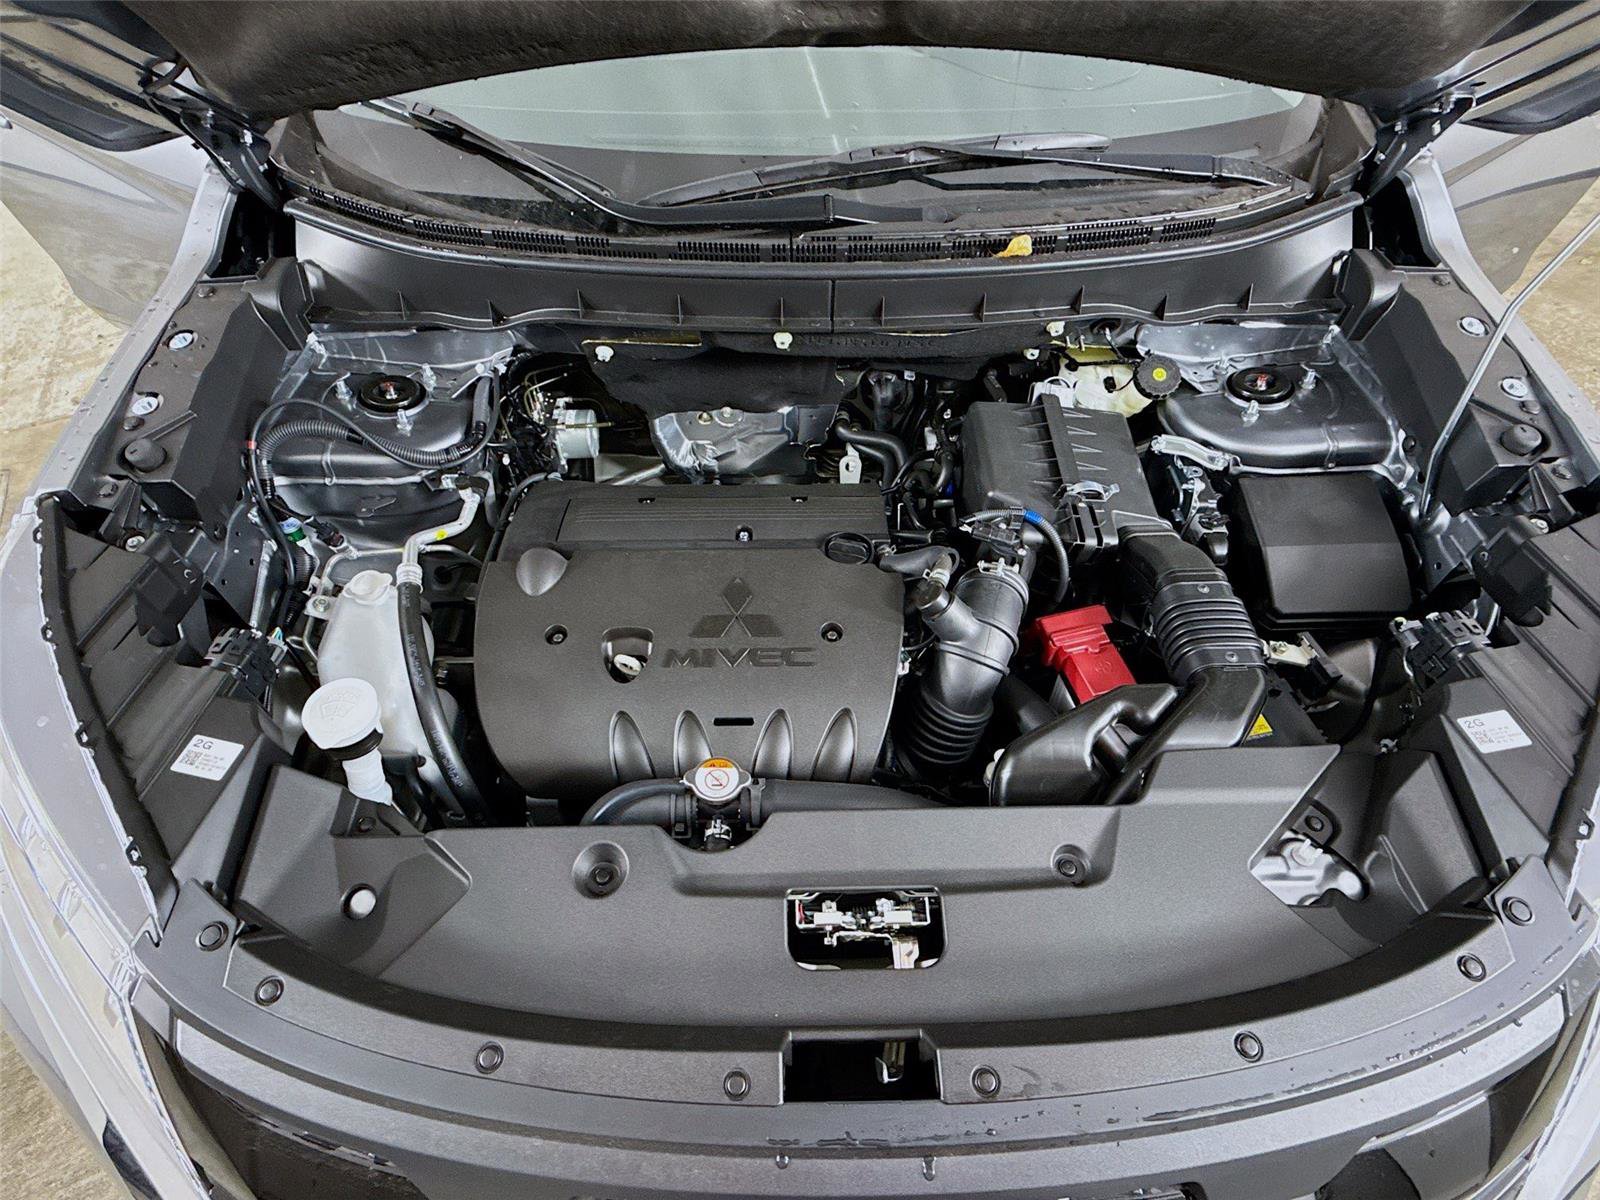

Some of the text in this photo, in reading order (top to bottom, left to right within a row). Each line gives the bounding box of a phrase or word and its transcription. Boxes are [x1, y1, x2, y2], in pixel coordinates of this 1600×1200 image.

[662, 648, 817, 668] MIVEC
[1464, 719, 1485, 729] 2G
[193, 738, 214, 750] 2G
